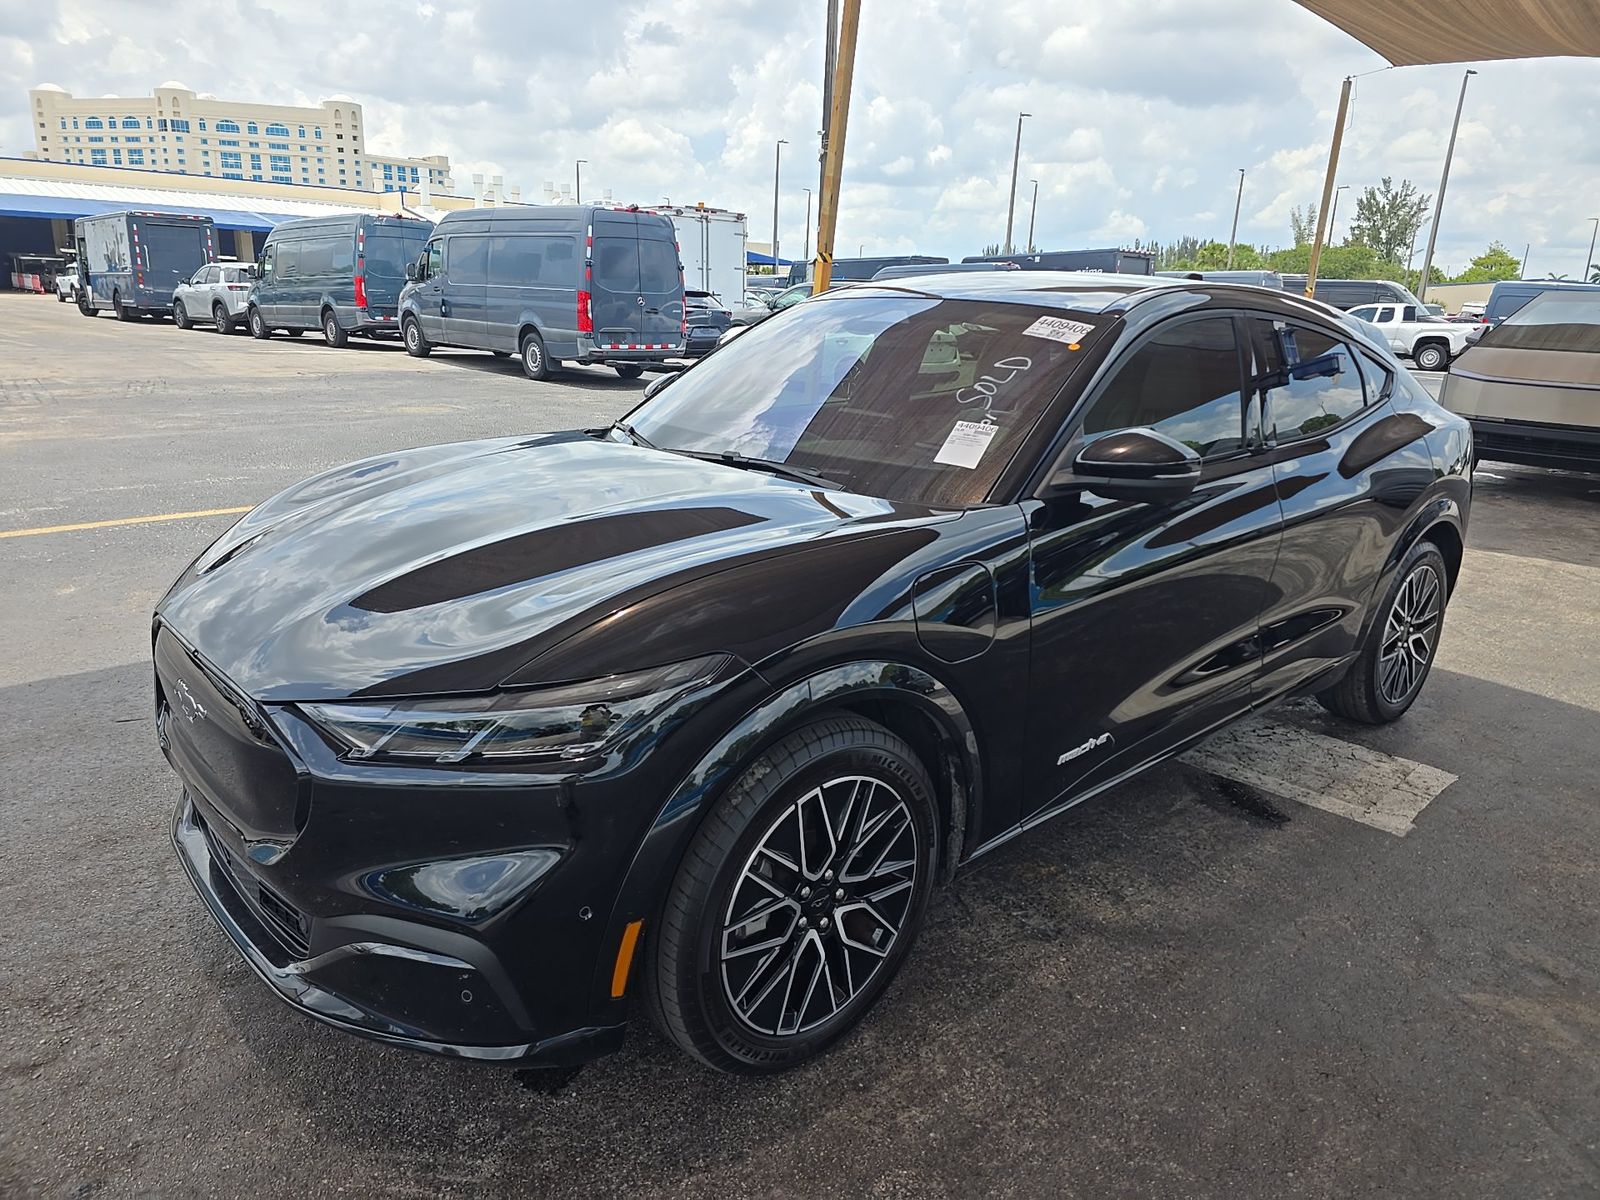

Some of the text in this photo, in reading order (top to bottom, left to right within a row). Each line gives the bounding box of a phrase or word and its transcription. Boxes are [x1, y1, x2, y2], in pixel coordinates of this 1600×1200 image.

[1038, 318, 1092, 335] 4409406
[956, 356, 1033, 410] SOLD
[957, 422, 998, 433] 4409406
[871, 754, 922, 798] MICHELIN
[724, 1031, 789, 1061] MICHELIN
